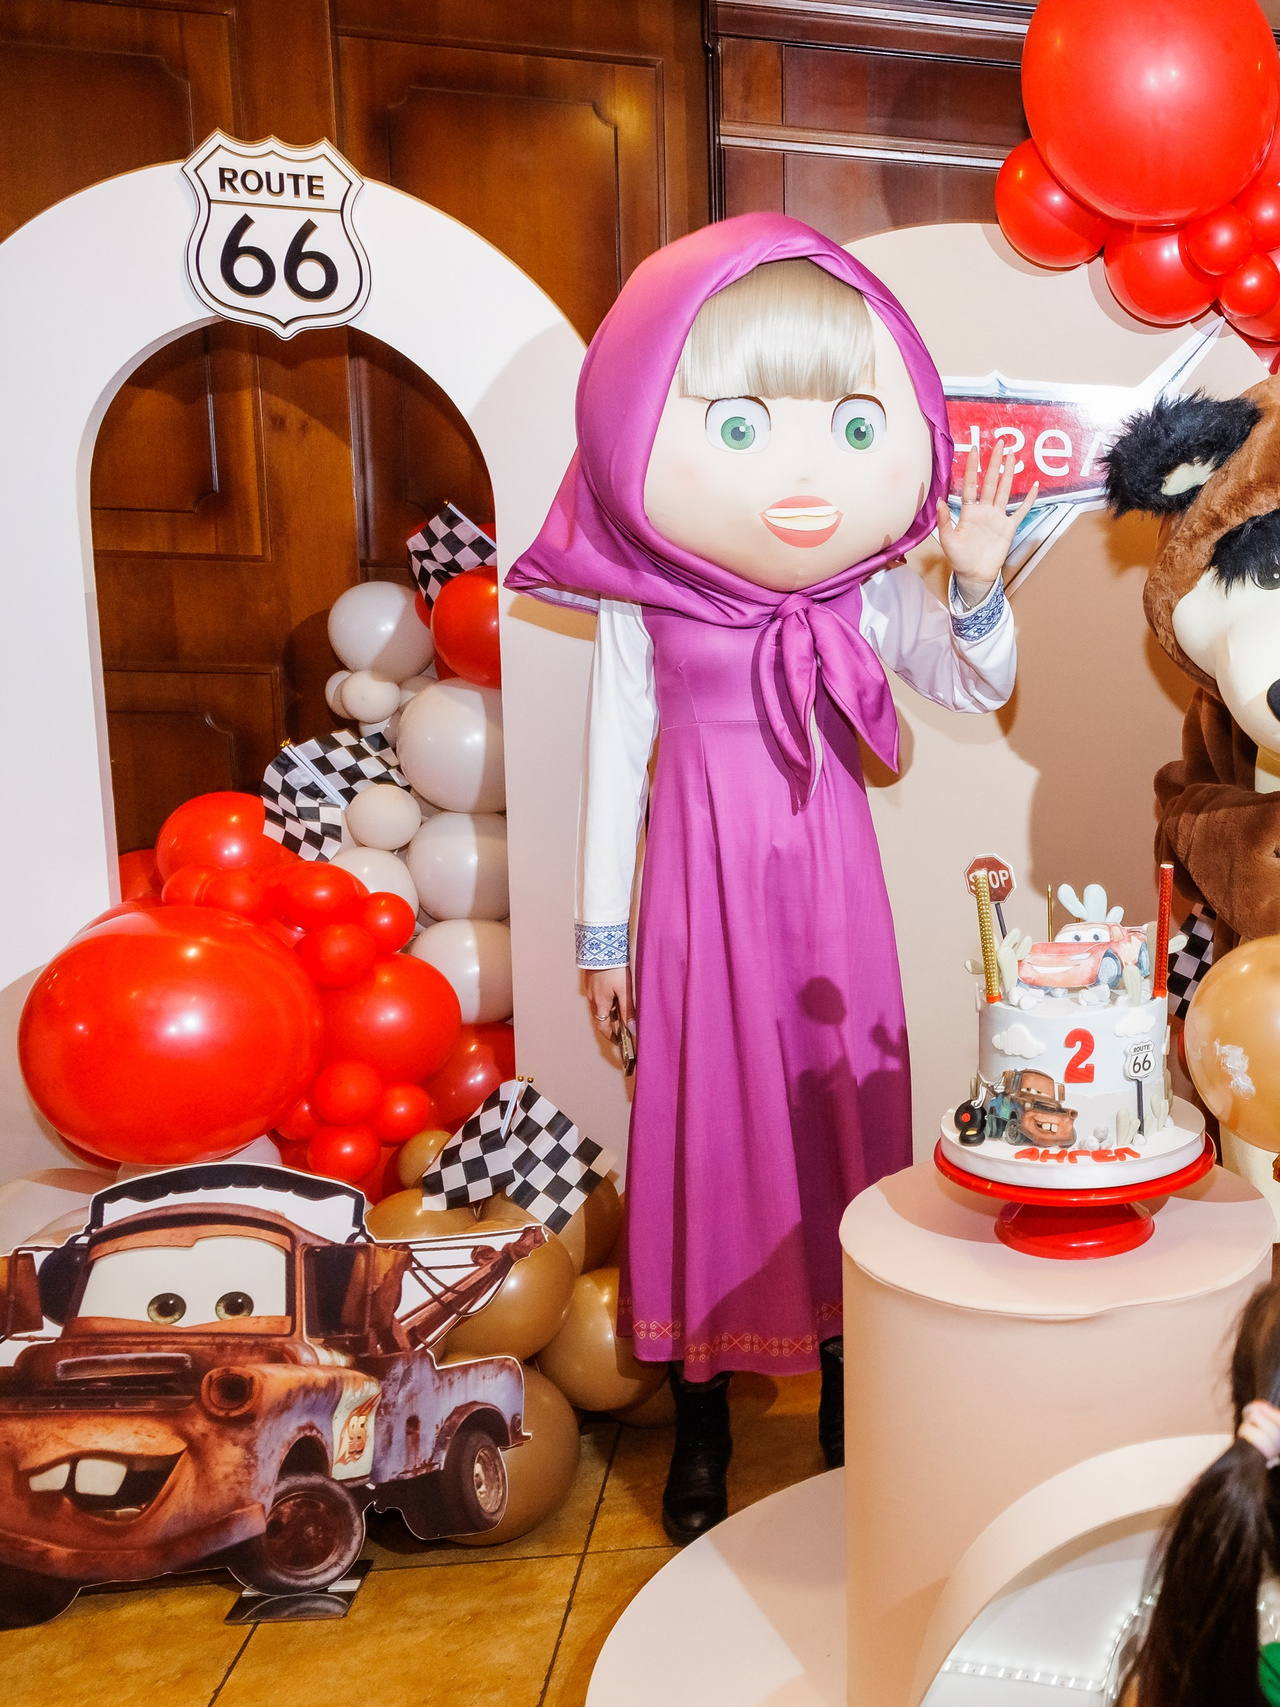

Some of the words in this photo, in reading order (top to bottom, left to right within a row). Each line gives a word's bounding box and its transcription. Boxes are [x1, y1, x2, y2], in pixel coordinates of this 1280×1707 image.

[218, 167, 325, 200] ROUTE
[220, 213, 339, 302] 66
[969, 869, 1010, 889] SOP
[1064, 1028, 1095, 1084] 2
[1133, 1044, 1150, 1053] ROUTE
[1133, 1054, 1151, 1073] 66
